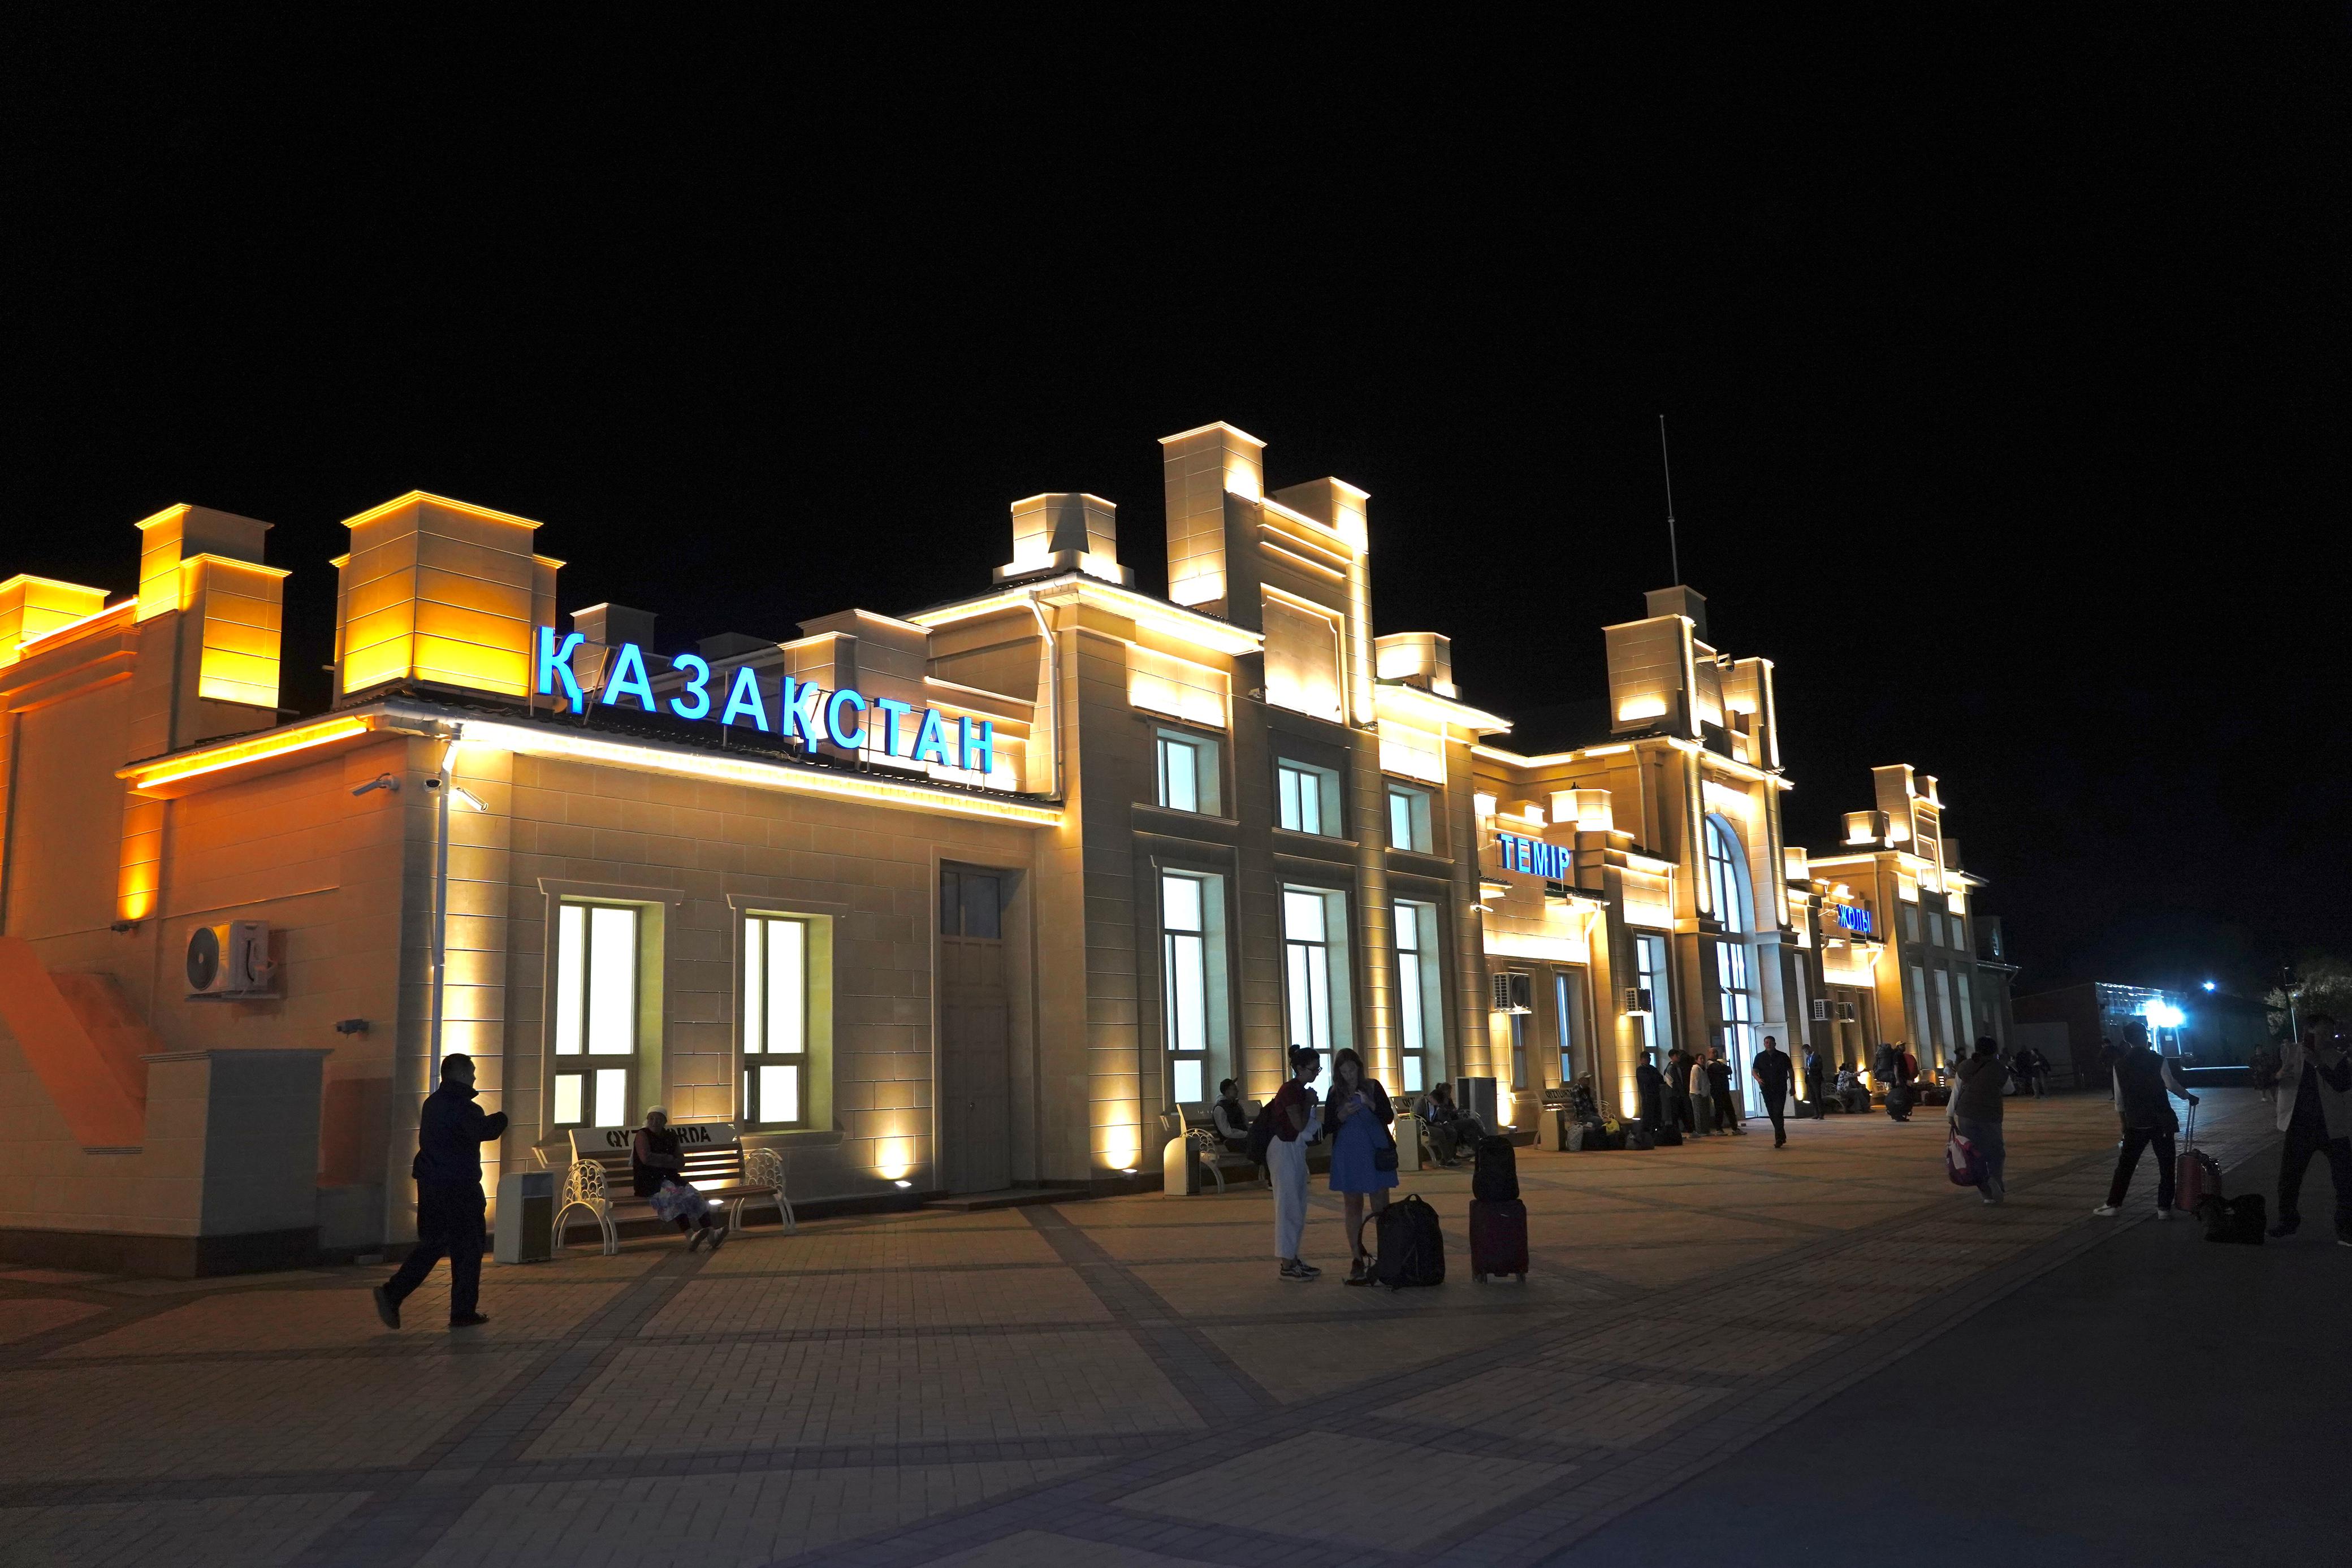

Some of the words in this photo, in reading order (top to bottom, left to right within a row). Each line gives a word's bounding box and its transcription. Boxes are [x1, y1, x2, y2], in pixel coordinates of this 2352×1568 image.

[537, 626, 993, 774] ҚАЗАҚСТАН
[1497, 833, 1570, 880] ТЕМІР
[1837, 904, 1871, 933] ЖОЛЫ
